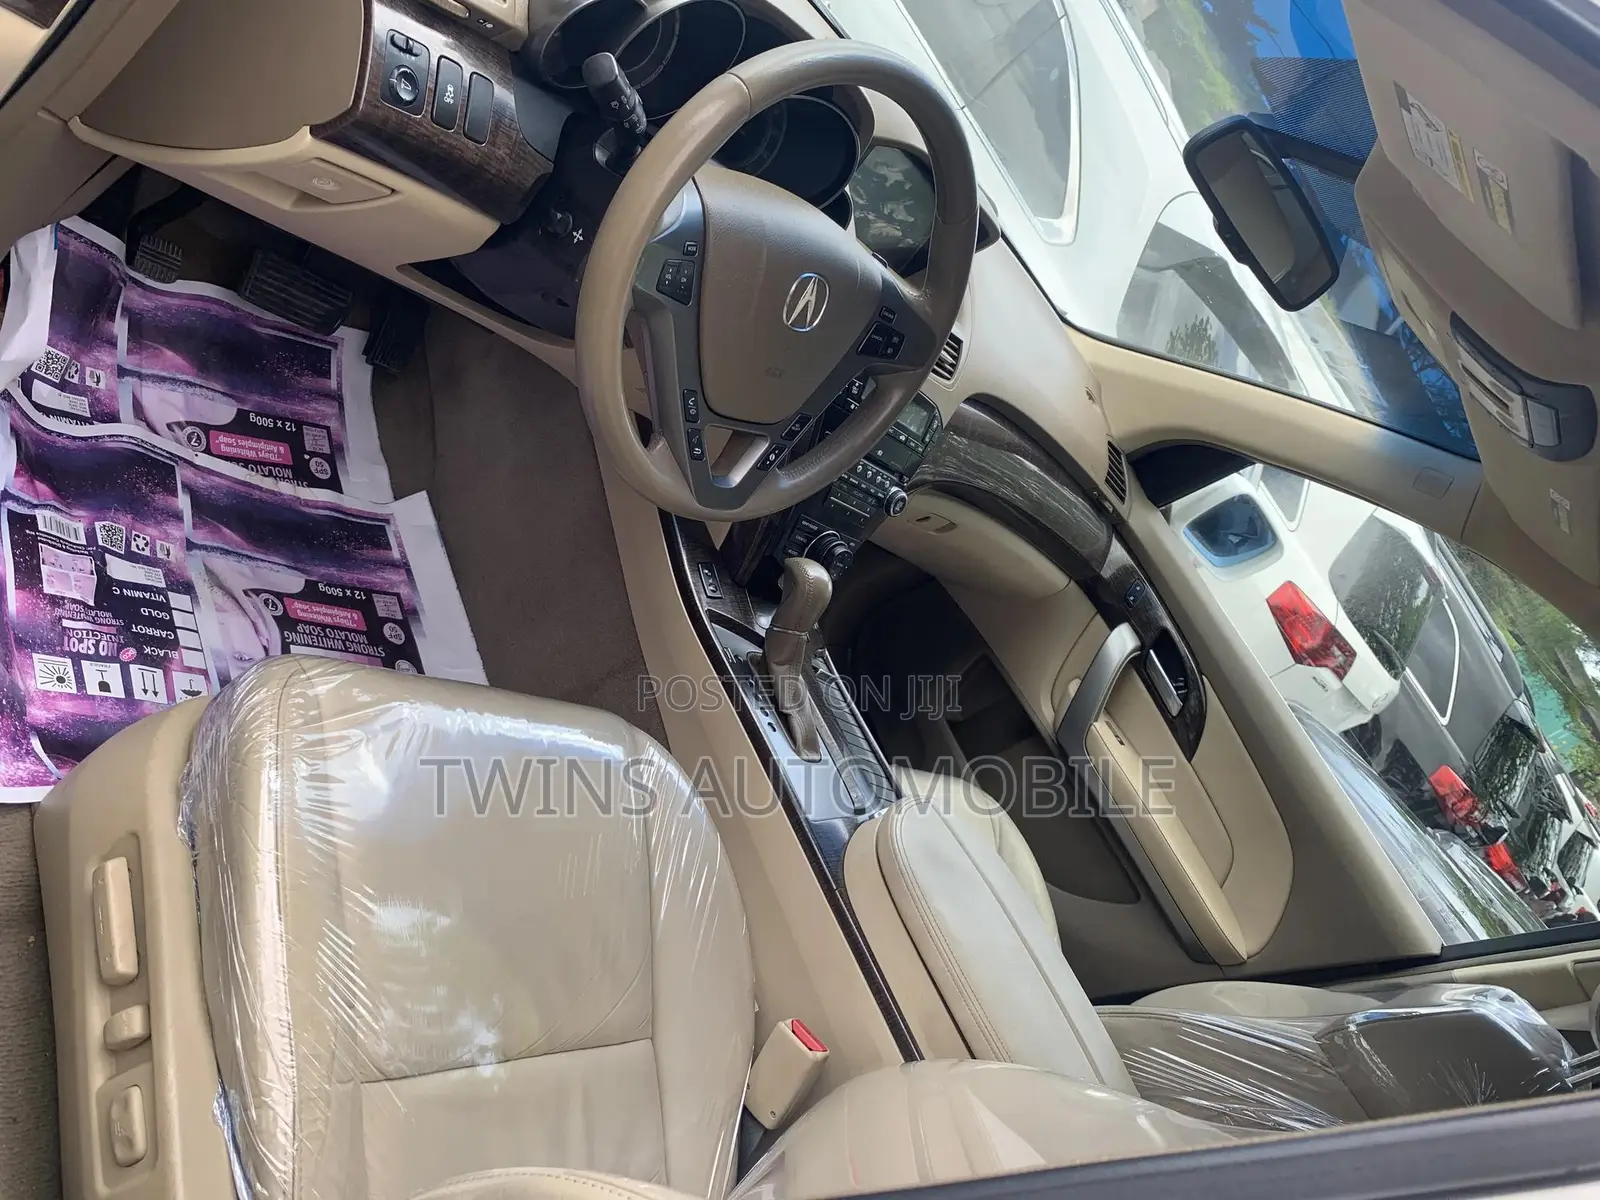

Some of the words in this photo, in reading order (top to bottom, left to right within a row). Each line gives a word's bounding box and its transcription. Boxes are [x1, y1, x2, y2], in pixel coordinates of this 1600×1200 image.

[250, 412, 274, 428] 500g
[285, 421, 297, 432] 12
[220, 444, 258, 458] Whitening
[111, 586, 120, 595] C
[123, 588, 167, 603] VITAMIN
[318, 582, 343, 597] 500g
[354, 590, 367, 600] 12
[63, 602, 85, 614] SOAP
[140, 607, 170, 620] GOLD
[95, 616, 124, 626] STRONG
[296, 609, 334, 623] Whitening
[63, 629, 125, 644] INJECTION
[131, 623, 175, 640] CARROT
[296, 623, 325, 636] SOAP
[326, 627, 368, 644] MOLATO
[62, 636, 96, 655] SPOT
[283, 630, 345, 650] WHITENING
[98, 640, 118, 657] NO
[142, 644, 179, 659] BLACK
[346, 644, 386, 657] STRONG
